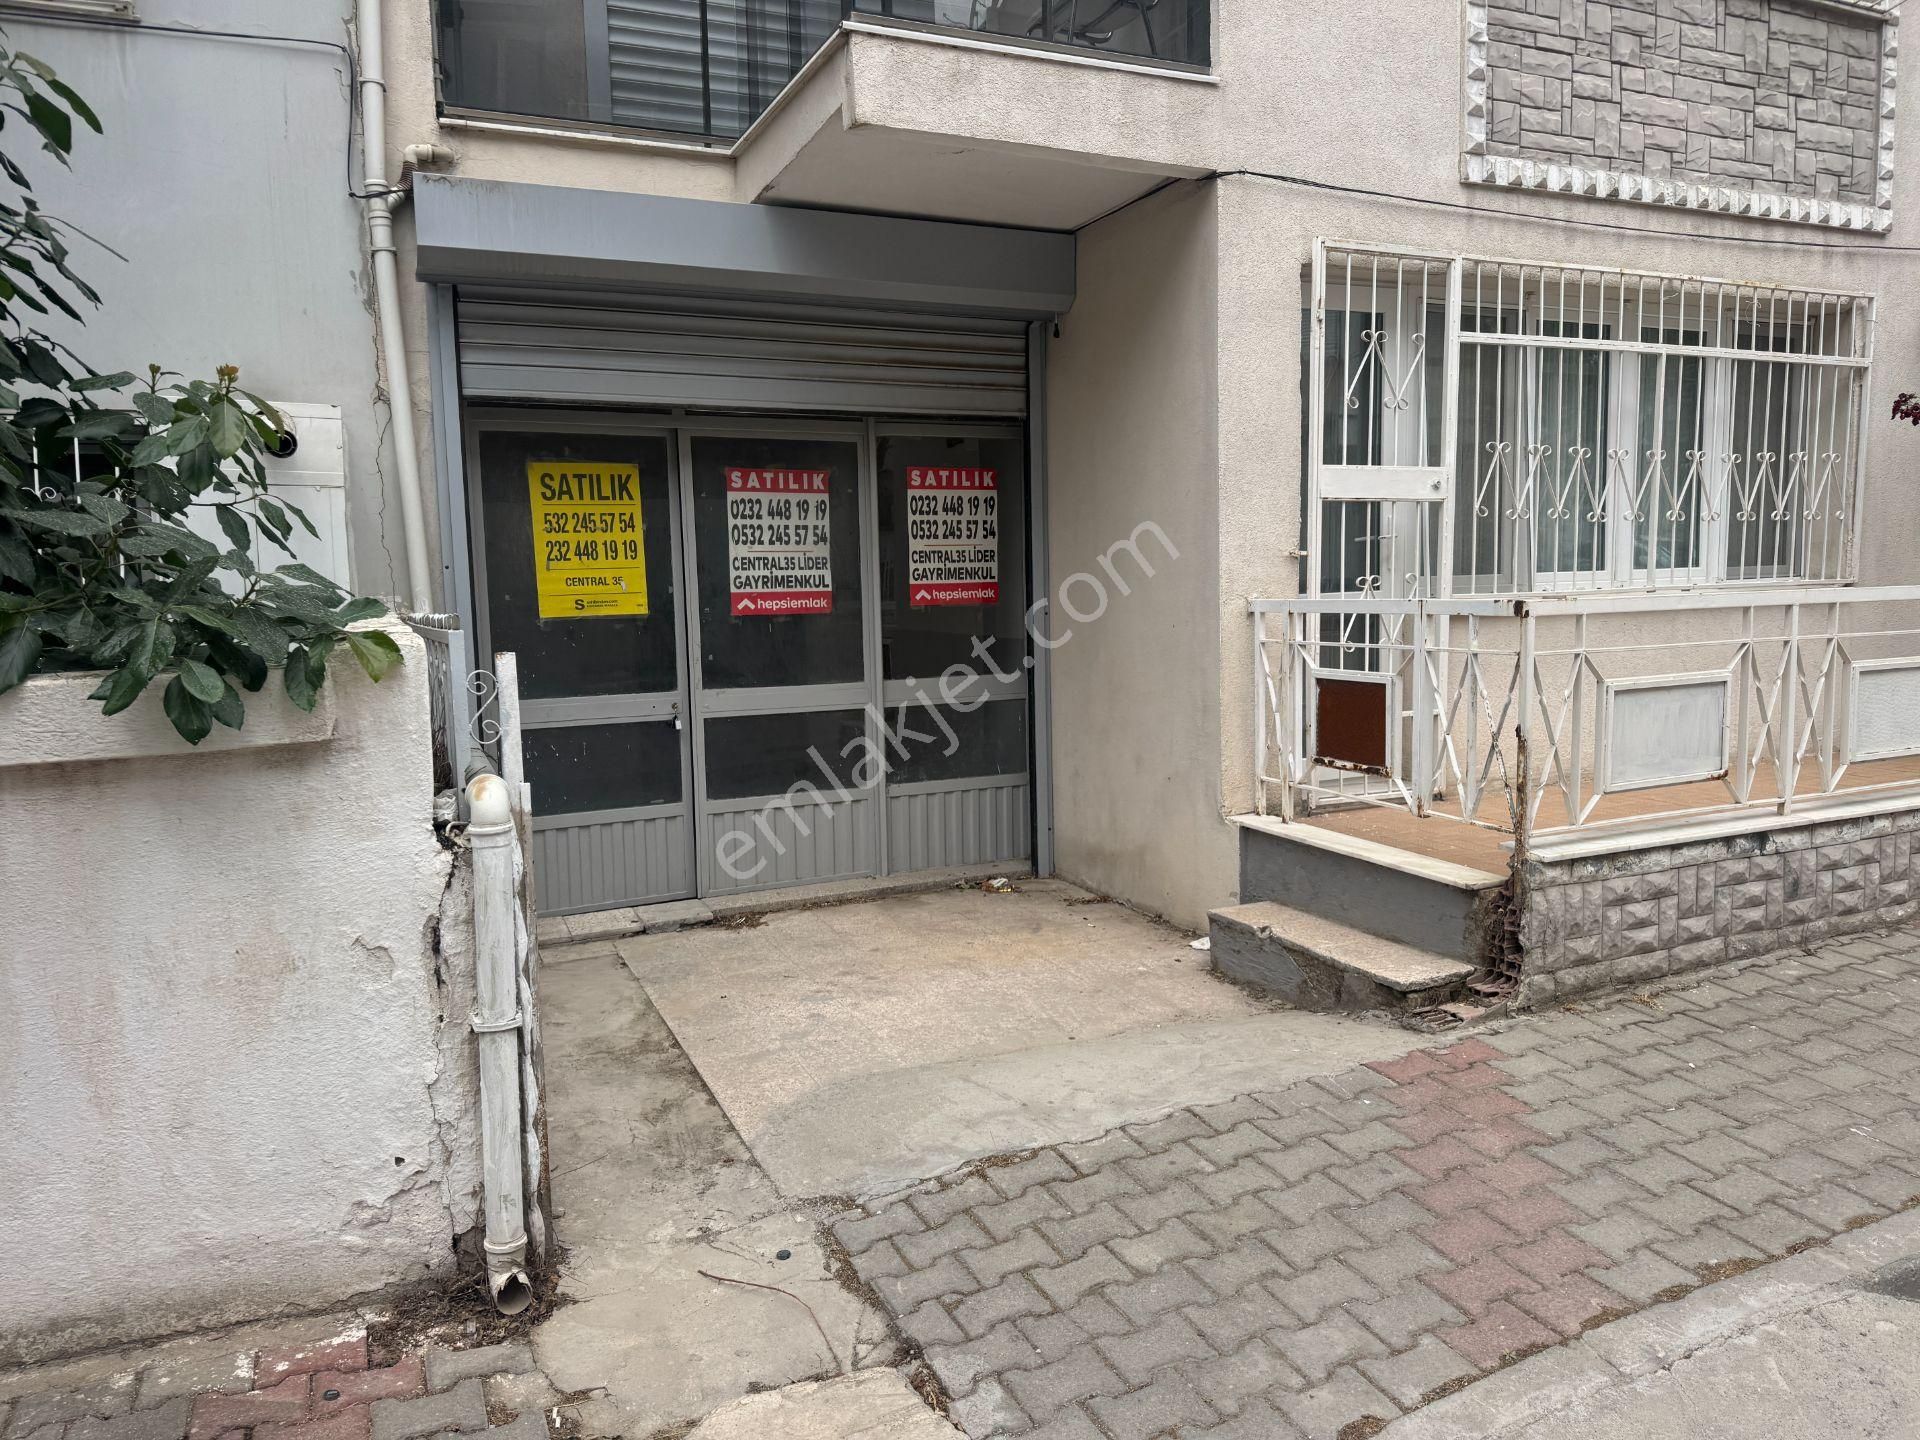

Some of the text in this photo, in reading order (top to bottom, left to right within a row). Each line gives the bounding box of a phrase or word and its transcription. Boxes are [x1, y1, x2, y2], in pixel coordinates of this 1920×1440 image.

[540, 472, 634, 501] SATILIK
[731, 471, 825, 490] SATILIK
[911, 470, 994, 487] SATILIK
[730, 498, 827, 520] 0232 448 19 19
[910, 495, 996, 516] 0232 448 19 19
[544, 512, 636, 534] 532 245 57 54
[911, 520, 996, 540] 0532 245 57 54
[731, 524, 828, 546] 0532 245 57 54
[546, 539, 638, 562] 232 448 19 19
[911, 546, 996, 564] CENTRAL35 LİDER
[732, 552, 828, 571] CENTRAL35 LİDER
[565, 577, 609, 587] CENTRAL
[733, 571, 830, 590] GAYRİMENKUL
[912, 563, 996, 582] GAYRİMENKUL
[757, 597, 828, 611] hepsiemlak
[932, 588, 996, 601] hepsiemlak
